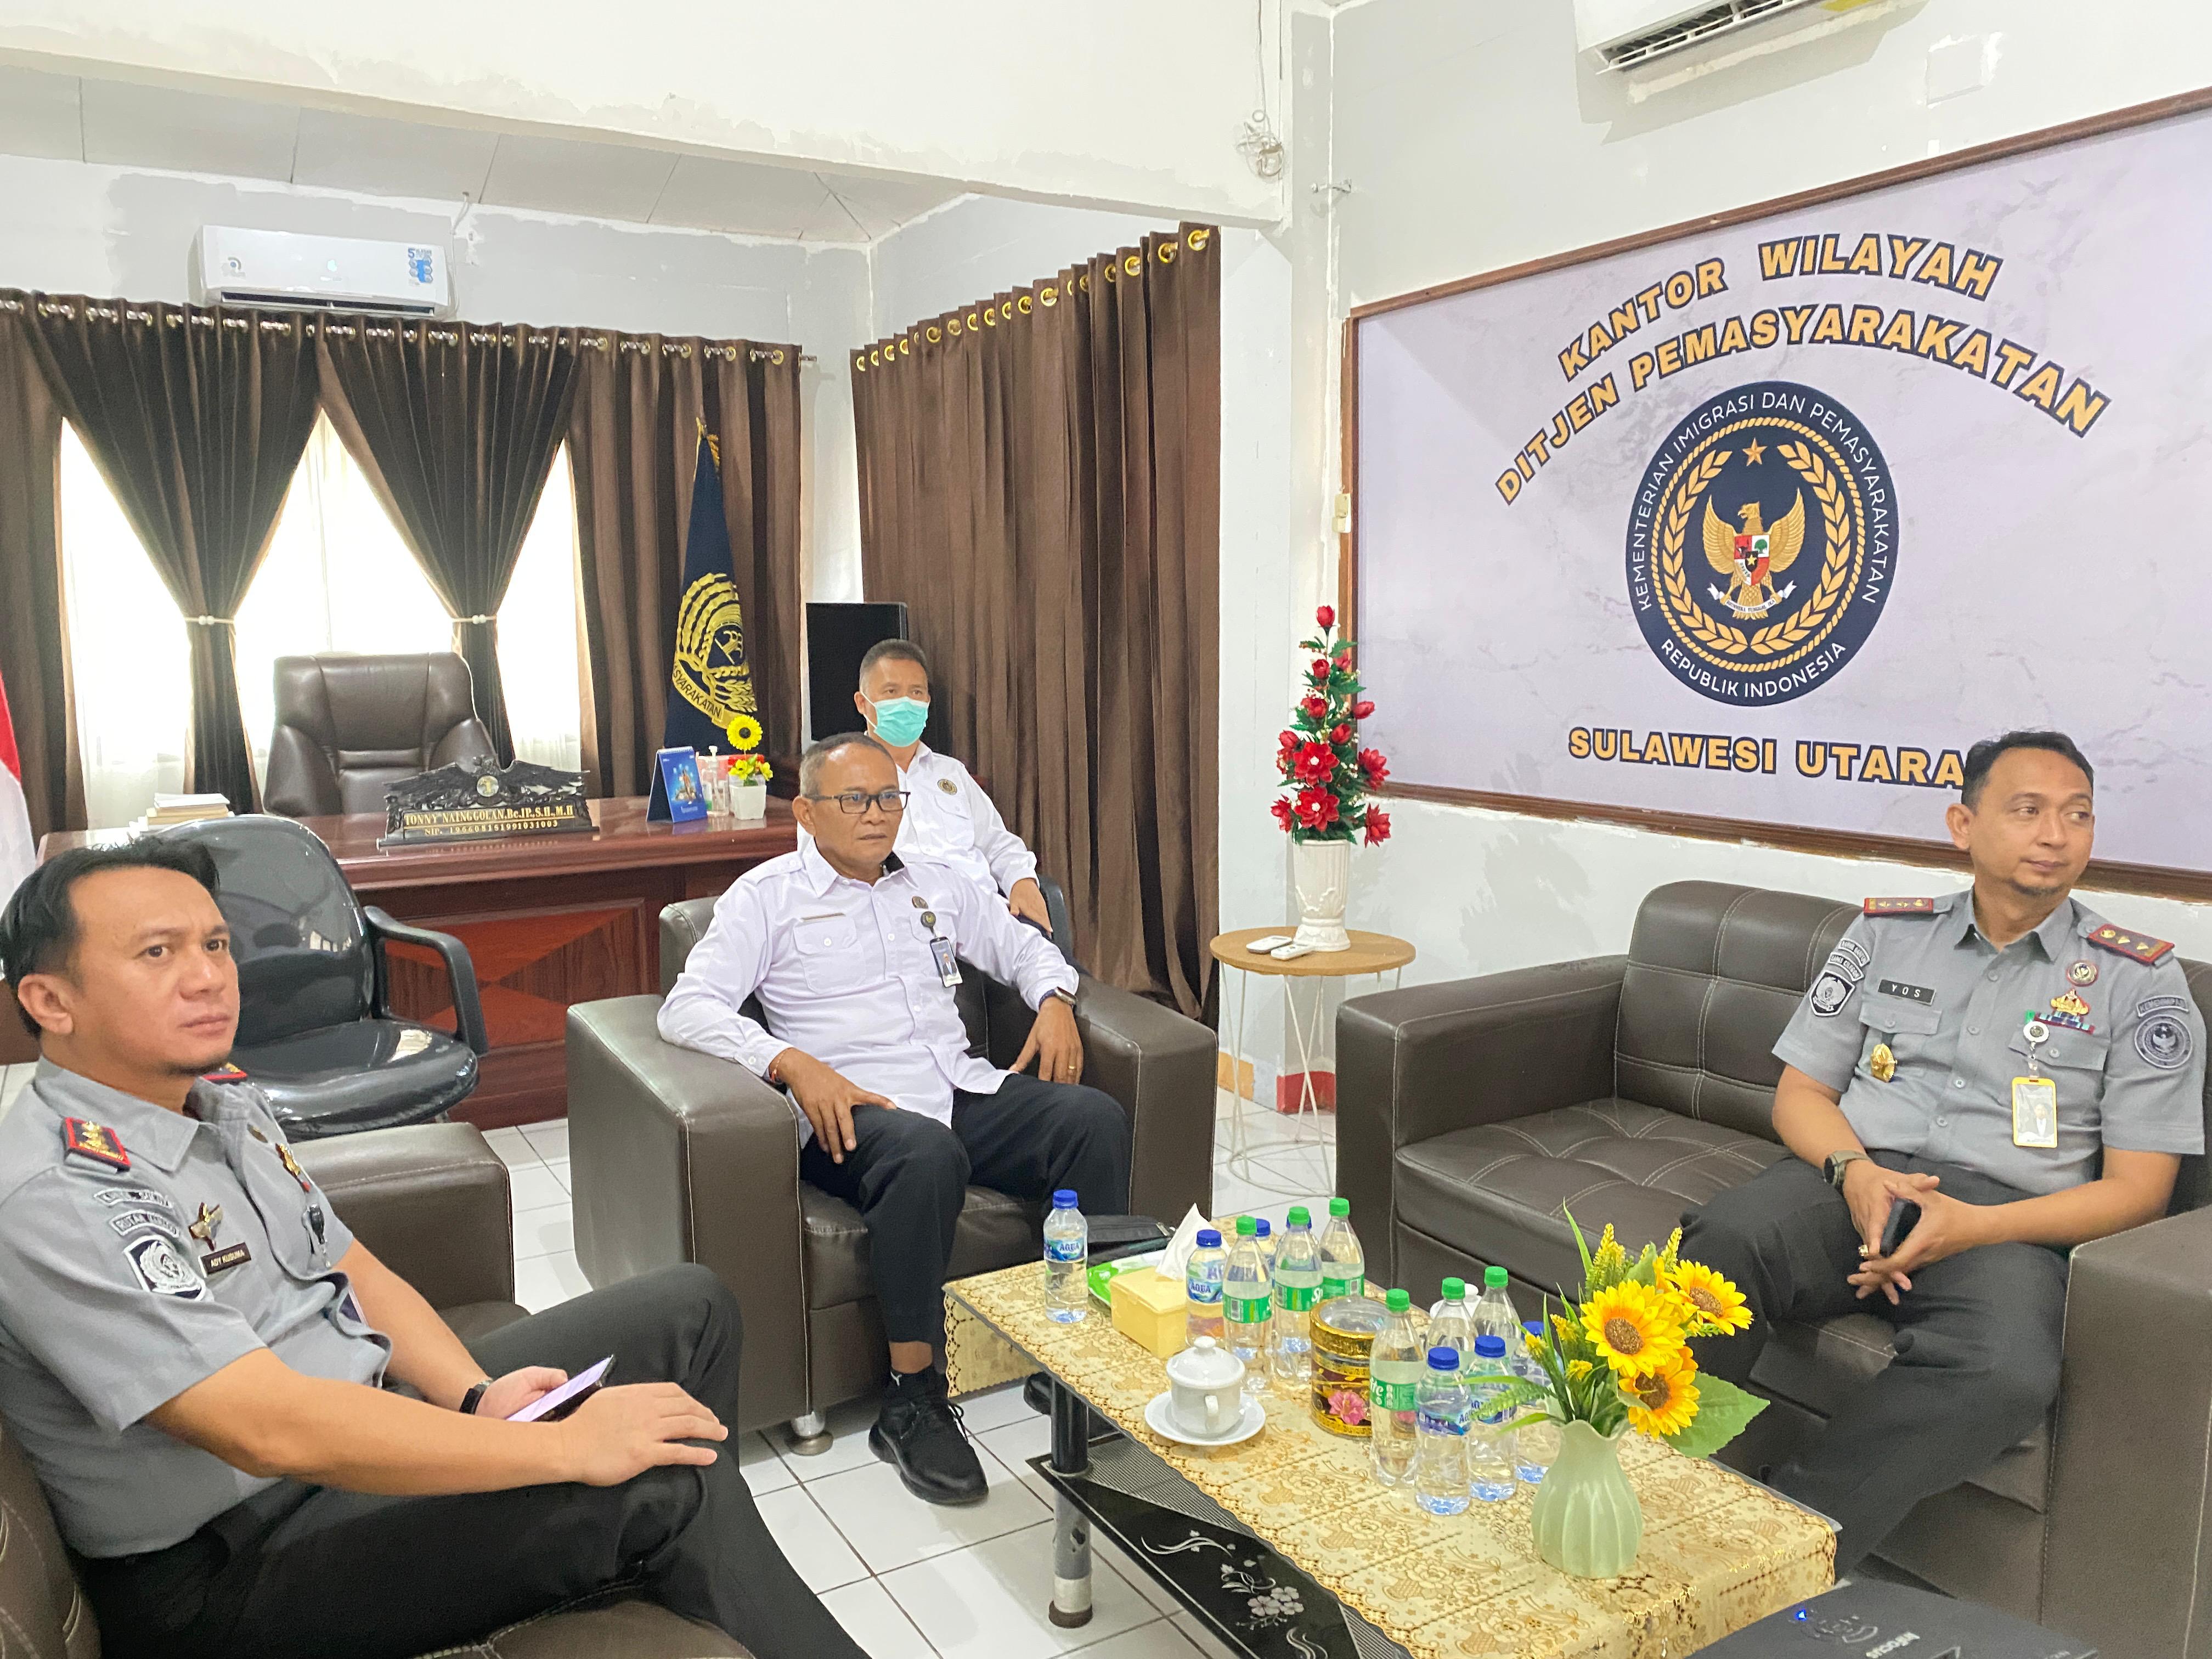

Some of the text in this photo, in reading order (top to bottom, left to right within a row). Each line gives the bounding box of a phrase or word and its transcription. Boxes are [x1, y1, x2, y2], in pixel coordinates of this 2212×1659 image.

[1558, 233, 2004, 382] KANTOR WILAYAH
[1494, 304, 2113, 506] DITJEN PEMASYARAKATAN
[1633, 392, 1889, 611] KEMENTERIAN IMIGRASI DAN PEMASYARAKATAN
[1661, 639, 1846, 698] REPUBLIK INDONESIA
[1568, 727, 1965, 789] SULAWESI UTARA
[404, 813, 438, 826] TONNY
[1059, 1243, 1080, 1251] AQUA
[1190, 1282, 1211, 1293] AQUA
